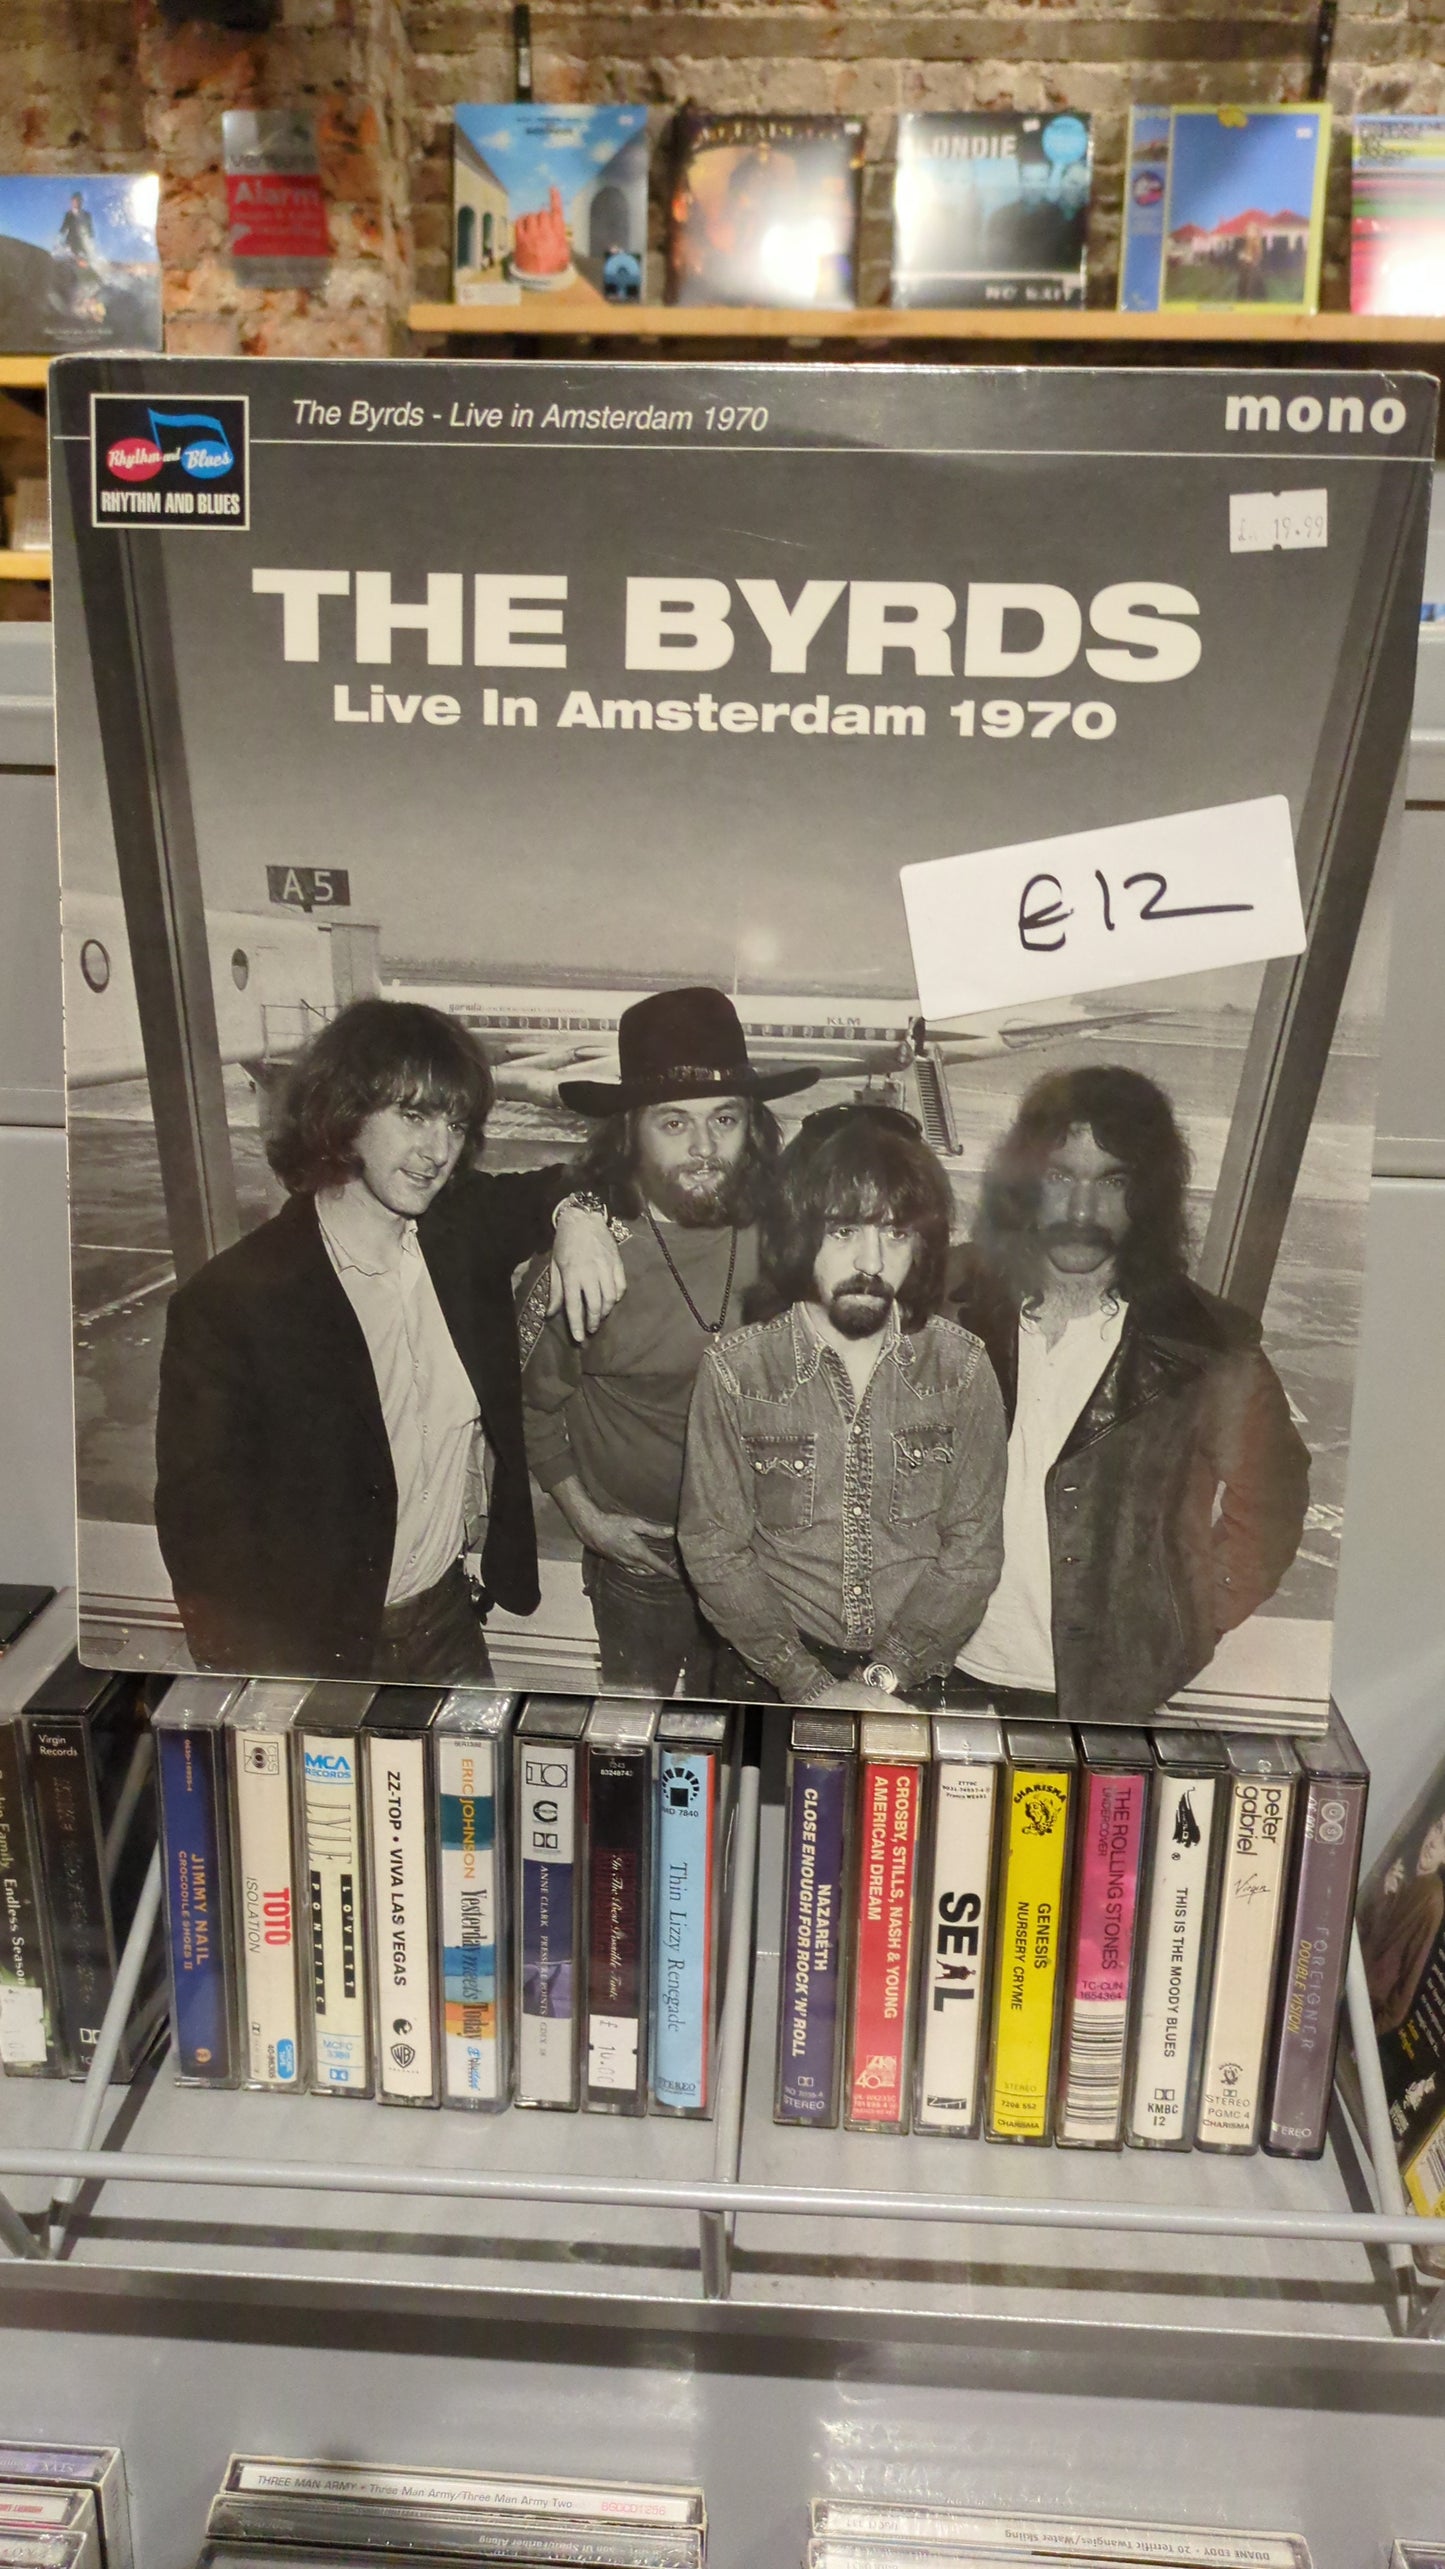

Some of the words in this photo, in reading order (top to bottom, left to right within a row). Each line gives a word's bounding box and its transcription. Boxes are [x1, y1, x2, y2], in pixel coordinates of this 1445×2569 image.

[930, 135, 1017, 159] ONDIE
[235, 180, 319, 206] Alarm
[293, 400, 343, 427] The
[350, 401, 424, 430] Byrds
[450, 402, 504, 429] Live
[511, 403, 536, 429] in
[541, 403, 693, 431] Amsterdam
[702, 405, 768, 432] 1970
[1225, 395, 1408, 435] mono
[107, 445, 162, 471] Rhythm
[184, 448, 232, 470] Blues
[101, 491, 161, 515] RHYTHM
[165, 492, 194, 515] AND
[197, 493, 241, 516] BLUES
[1273, 515, 1325, 541] 19.99
[252, 568, 568, 669] THE
[624, 575, 1202, 683] BYRDS
[334, 684, 461, 727] Live
[484, 688, 538, 727] In
[557, 690, 926, 737] Amsterdam
[951, 700, 1118, 740] 1970
[827, 1016, 861, 1026] KLM
[38, 1734, 67, 1747] Virgin
[39, 1746, 78, 1757] Records
[304, 1752, 351, 1771] MCA
[305, 1768, 352, 1779] RECORDS
[461, 1758, 475, 1795] ERIC
[387, 1770, 403, 1831] ZZ-TOP
[889, 1775, 911, 1843] CROSBY,
[1013, 1783, 1067, 1804] CHARISMA
[1113, 1787, 1132, 1822] THE
[678, 1810, 699, 1818] 7840
[802, 1787, 819, 1842] CLOSE
[870, 1775, 889, 1861] AMERICAN
[1097, 1787, 1112, 1857] UNDERCOVER
[1234, 1785, 1263, 1857] gabriel
[1260, 1787, 1284, 1844] peter
[459, 1797, 477, 1880] JOHNSON
[389, 1848, 404, 1888] VIVA
[540, 1865, 549, 1894] ANNE
[610, 1854, 623, 1870] In
[799, 1843, 816, 1915] ENOUGH
[886, 1846, 907, 1904] STILLS,
[1106, 1823, 1129, 1900] ROLLING
[178, 1850, 191, 1917] CROCODILE
[192, 1853, 208, 1913] JIMMY
[610, 1872, 624, 1895] The
[669, 1862, 689, 1903] Thin
[867, 1863, 885, 1921] DREAM
[1233, 1872, 1271, 1905] Virgin
[4, 1878, 21, 1932] Endless
[246, 1876, 262, 1954] ISOLATION
[263, 1887, 292, 1946] TOTO
[391, 1893, 406, 1926] LAS
[456, 1888, 488, 1951] Yesterday
[540, 1896, 549, 1927] CLARK
[610, 1897, 623, 1924] Best
[1175, 1887, 1189, 1918] THIS
[183, 1921, 193, 1958] SHOES
[194, 1920, 210, 1966] NAIL
[311, 1882, 325, 2004] PONTIAC
[663, 1910, 688, 1953] Lizzy
[797, 1914, 813, 1948] FOR
[814, 1884, 833, 1972] NAZARETH
[887, 1905, 904, 1949] NASH
[1014, 1901, 1030, 1963] NURSERY
[1034, 1902, 1052, 1969] GENESIS
[1101, 1902, 1123, 1970] STONES
[1173, 1920, 1186, 1933] IS
[392, 1930, 407, 1987] VEGAS
[609, 1924, 624, 1968] Possible
[886, 1951, 901, 1963] &
[933, 1891, 982, 2013] SEAL
[1171, 1936, 1185, 1963] THE
[1294, 1938, 1313, 1991] DOUBLE
[462, 1949, 483, 2000] meets
[608, 1970, 624, 2001] Taste
[794, 1949, 811, 1995] ROCK
[1010, 1966, 1025, 2012] CRYME
[1081, 1979, 1124, 1991] TC-CUN
[1167, 1965, 1183, 2014] MOODY
[1301, 1926, 1330, 2050] FOREIGNER
[539, 1982, 549, 2015] POINTS
[662, 1958, 687, 2033] Renegade
[883, 1966, 901, 2020] YOUNG
[456, 2000, 489, 2041] Today
[1286, 1992, 1306, 2034] VISION
[791, 2017, 807, 2057] ROLL
[1163, 2016, 1179, 2058] BLUES
[783, 2095, 825, 2111] STEREO
[1003, 2081, 1038, 2092] STEREO
[1204, 2094, 1251, 2108] STEREO
[997, 2118, 1040, 2130] CHARISMA
[1147, 2102, 1179, 2115] KMBC
[1153, 2115, 1166, 2126] 12
[1202, 2118, 1251, 2131] CHARISMA
[1207, 2107, 1241, 2119] PGMC
[1243, 2110, 1250, 2119] 4
[1275, 2124, 1313, 2139] EREO
[258, 2475, 292, 2487] THREE
[295, 2477, 321, 2489] MAN
[324, 2480, 358, 2492] ARMY
[370, 2483, 399, 2496] Three
[401, 2486, 425, 2497] Man
[494, 2492, 518, 2505] Man
[521, 2495, 549, 2509] Army
[552, 2498, 573, 2509] Two
[478, 2535, 509, 2549] Along
[1135, 2540, 1174, 2554] Terrific
[1177, 2544, 1191, 2555] 20
[1203, 2546, 1232, 2558] EDDY
[1233, 2549, 1271, 2561] DUANE
